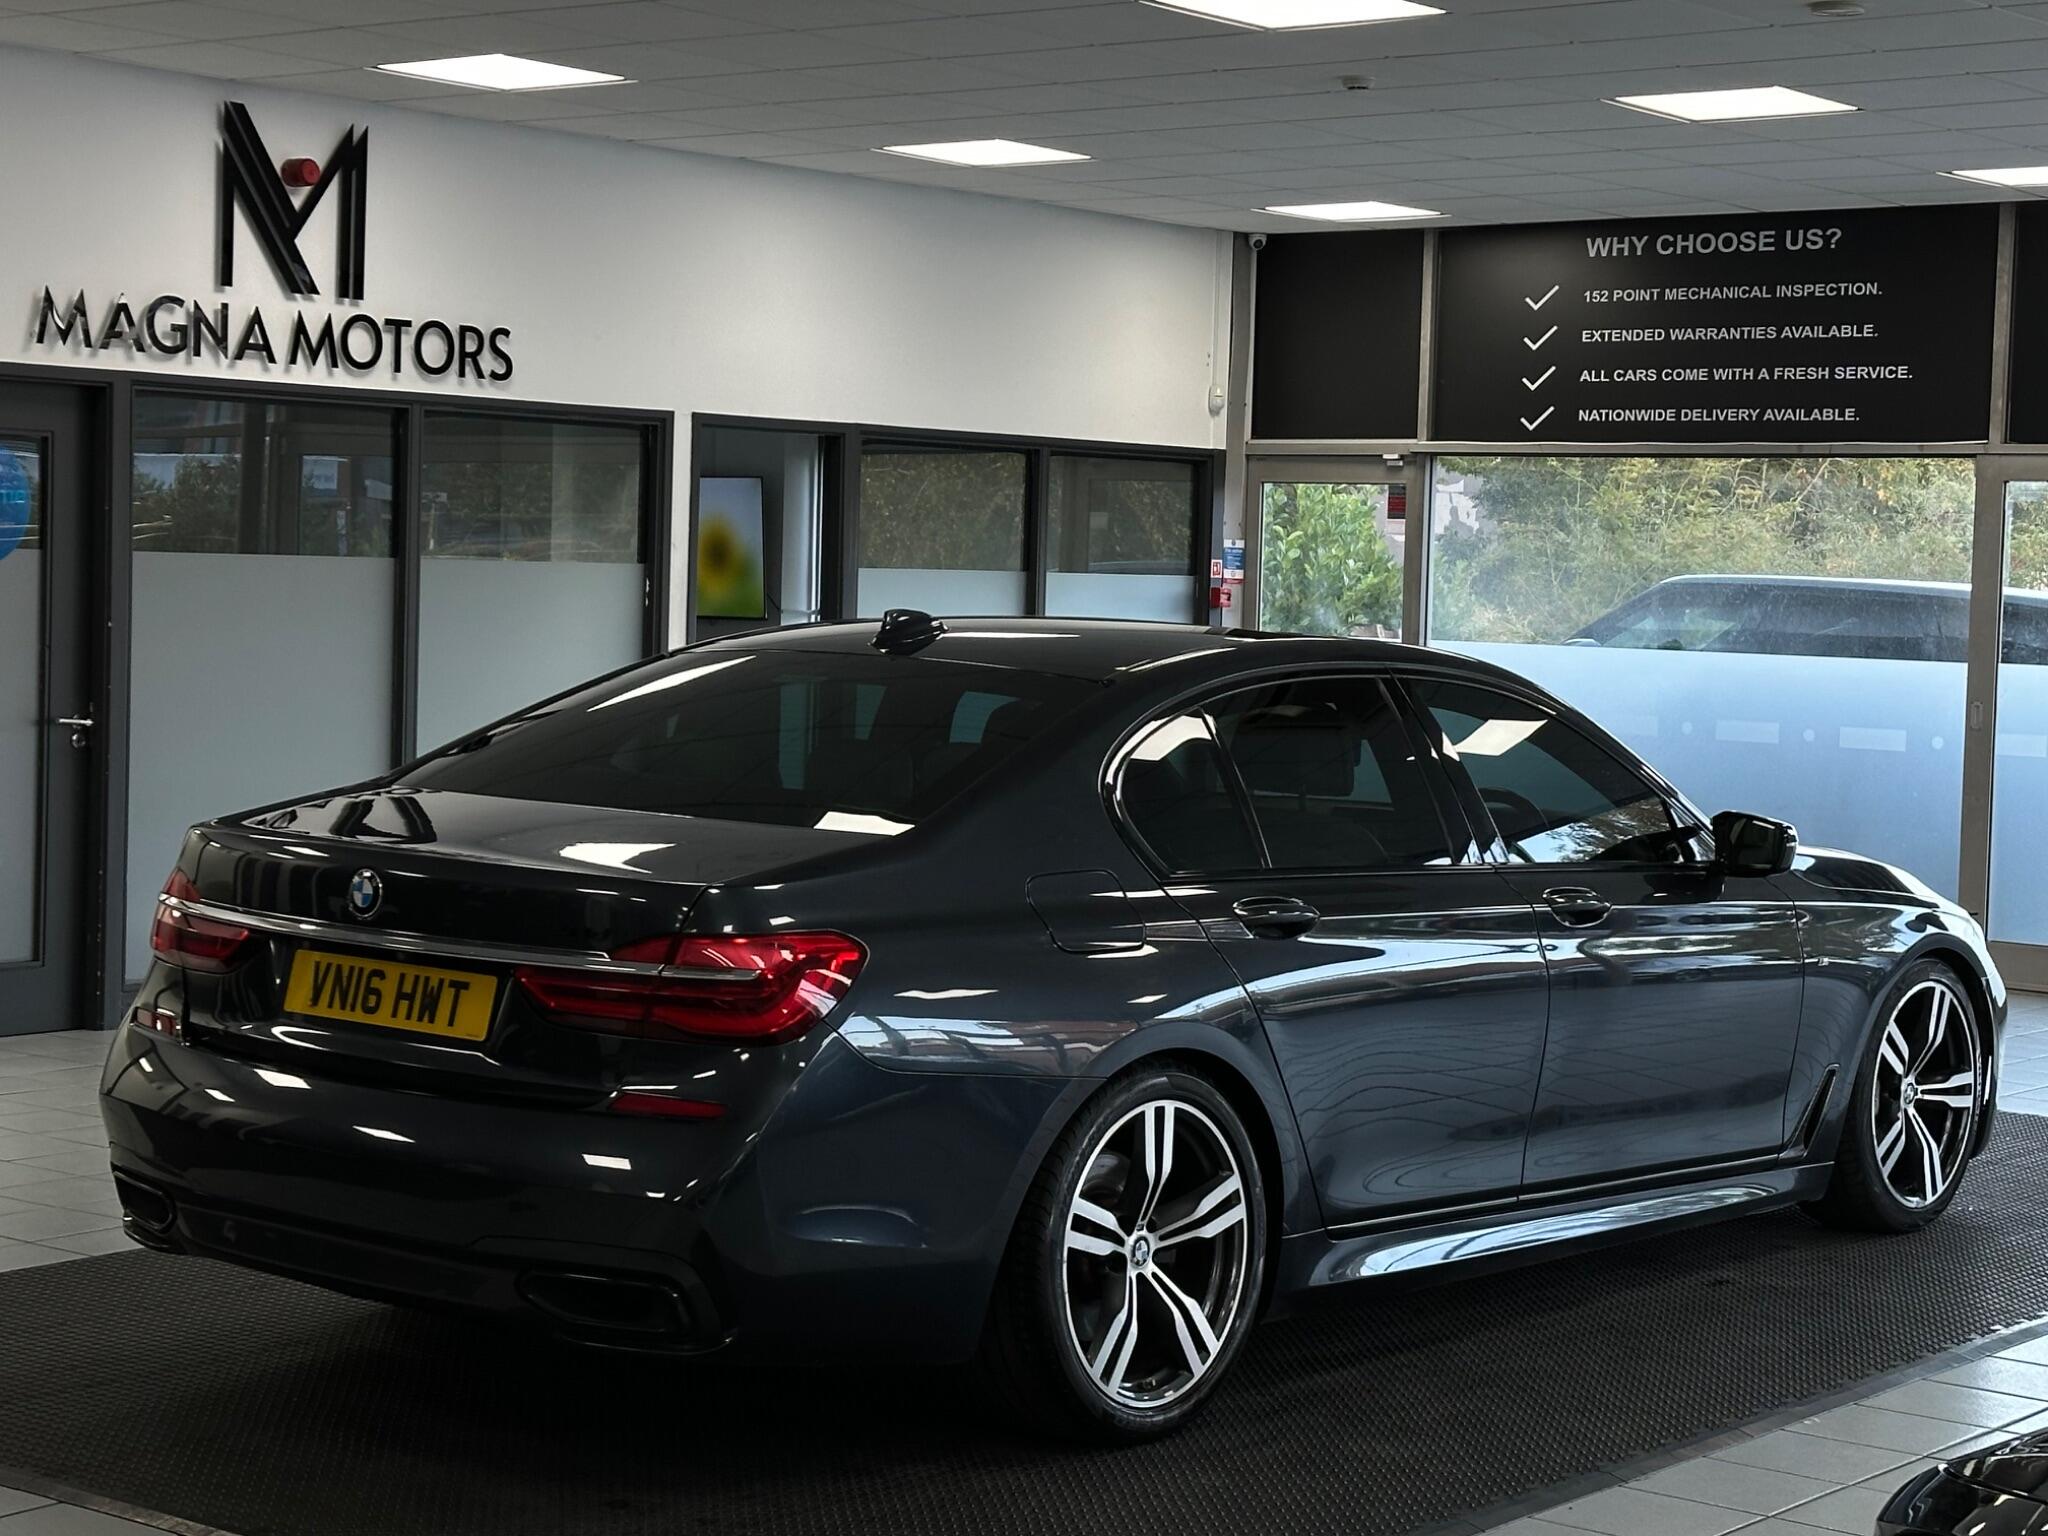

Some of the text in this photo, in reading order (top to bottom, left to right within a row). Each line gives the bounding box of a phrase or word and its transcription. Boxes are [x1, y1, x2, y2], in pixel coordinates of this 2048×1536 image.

[1585, 227, 1843, 258] WHY CHOOSE US?
[1583, 281, 1883, 304] 152 POINT MECHANICAL INSPECTION.
[35, 285, 514, 382] MAGNA MOTORS
[1581, 323, 1879, 343] EXTENDED WARRANTIES AVAILABLE.
[1579, 365, 1913, 383] ALL CARS COME WITH A FRESH SERVICE.
[1578, 407, 1860, 422] NATIONWIDE DELIVERY AVAILABLE.
[310, 960, 471, 1027] VN16 HWT
